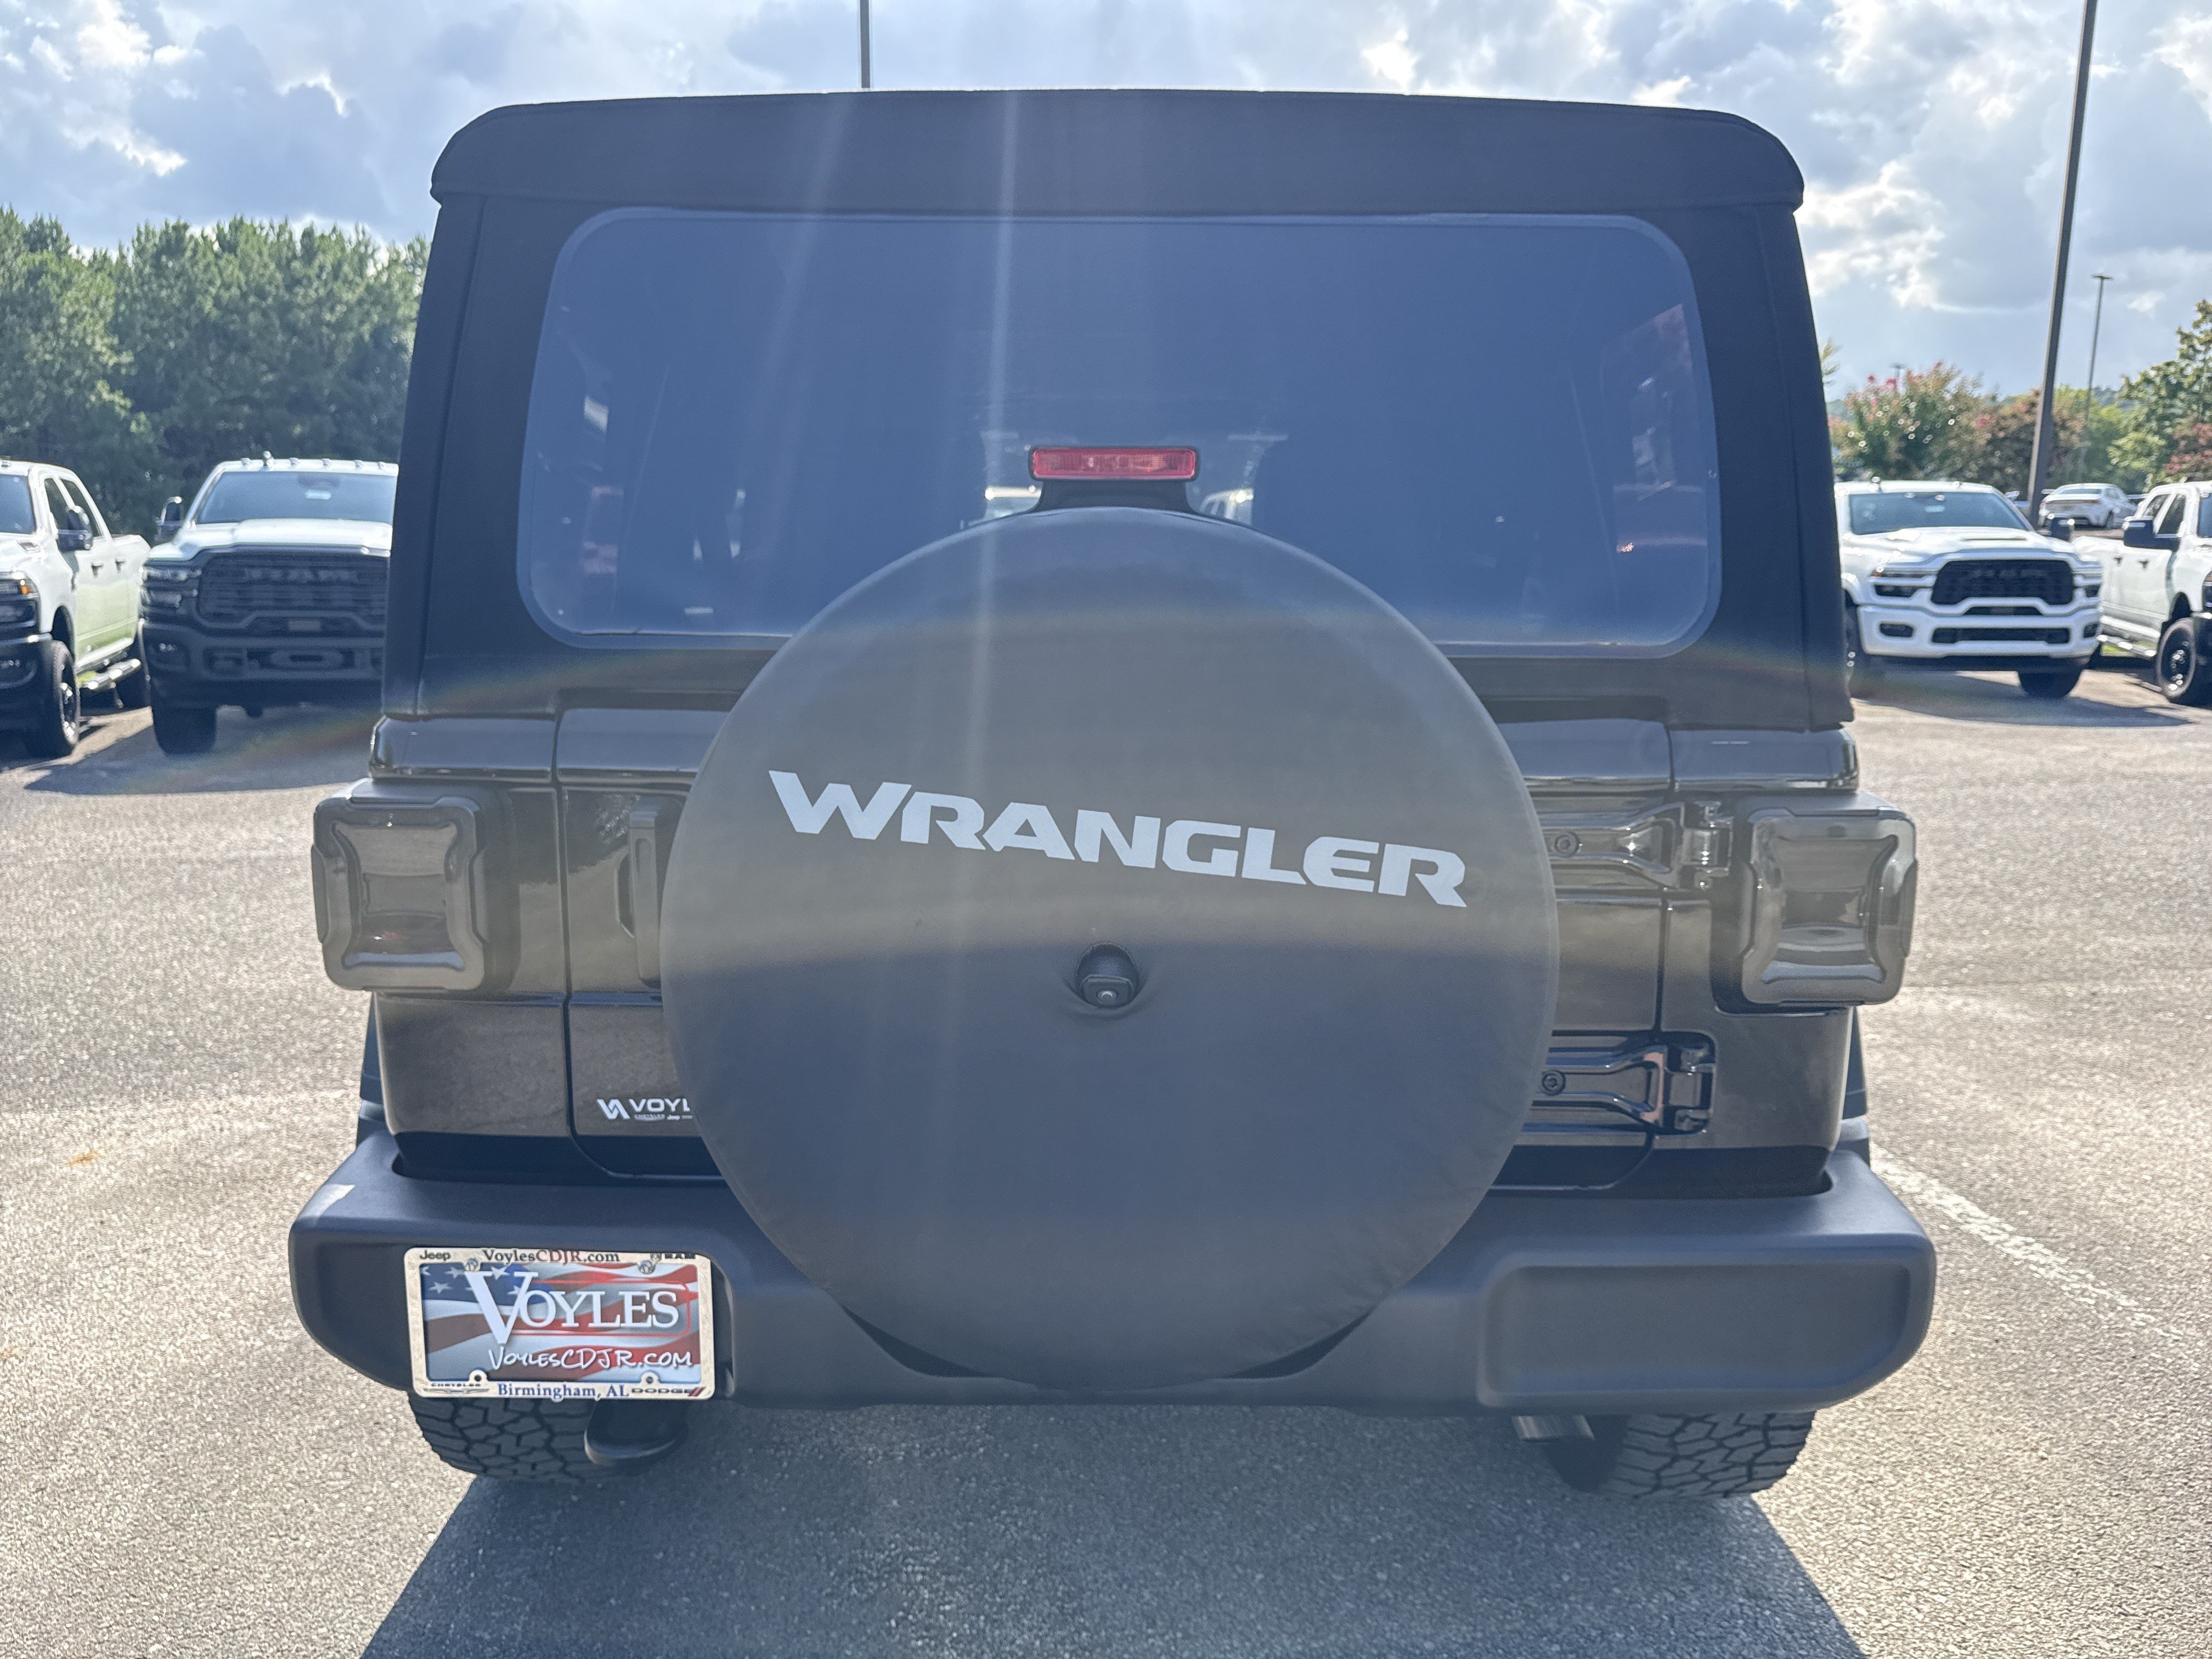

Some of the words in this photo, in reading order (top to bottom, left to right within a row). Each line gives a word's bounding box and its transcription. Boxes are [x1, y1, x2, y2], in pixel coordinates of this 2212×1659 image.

[768, 770, 1468, 908] WRANGLER
[420, 1249, 451, 1261] Jeep
[482, 1249, 620, 1266] VoylesCDJR.com
[498, 1383, 601, 1401] Birmingham,
[606, 1384, 629, 1397] AL
